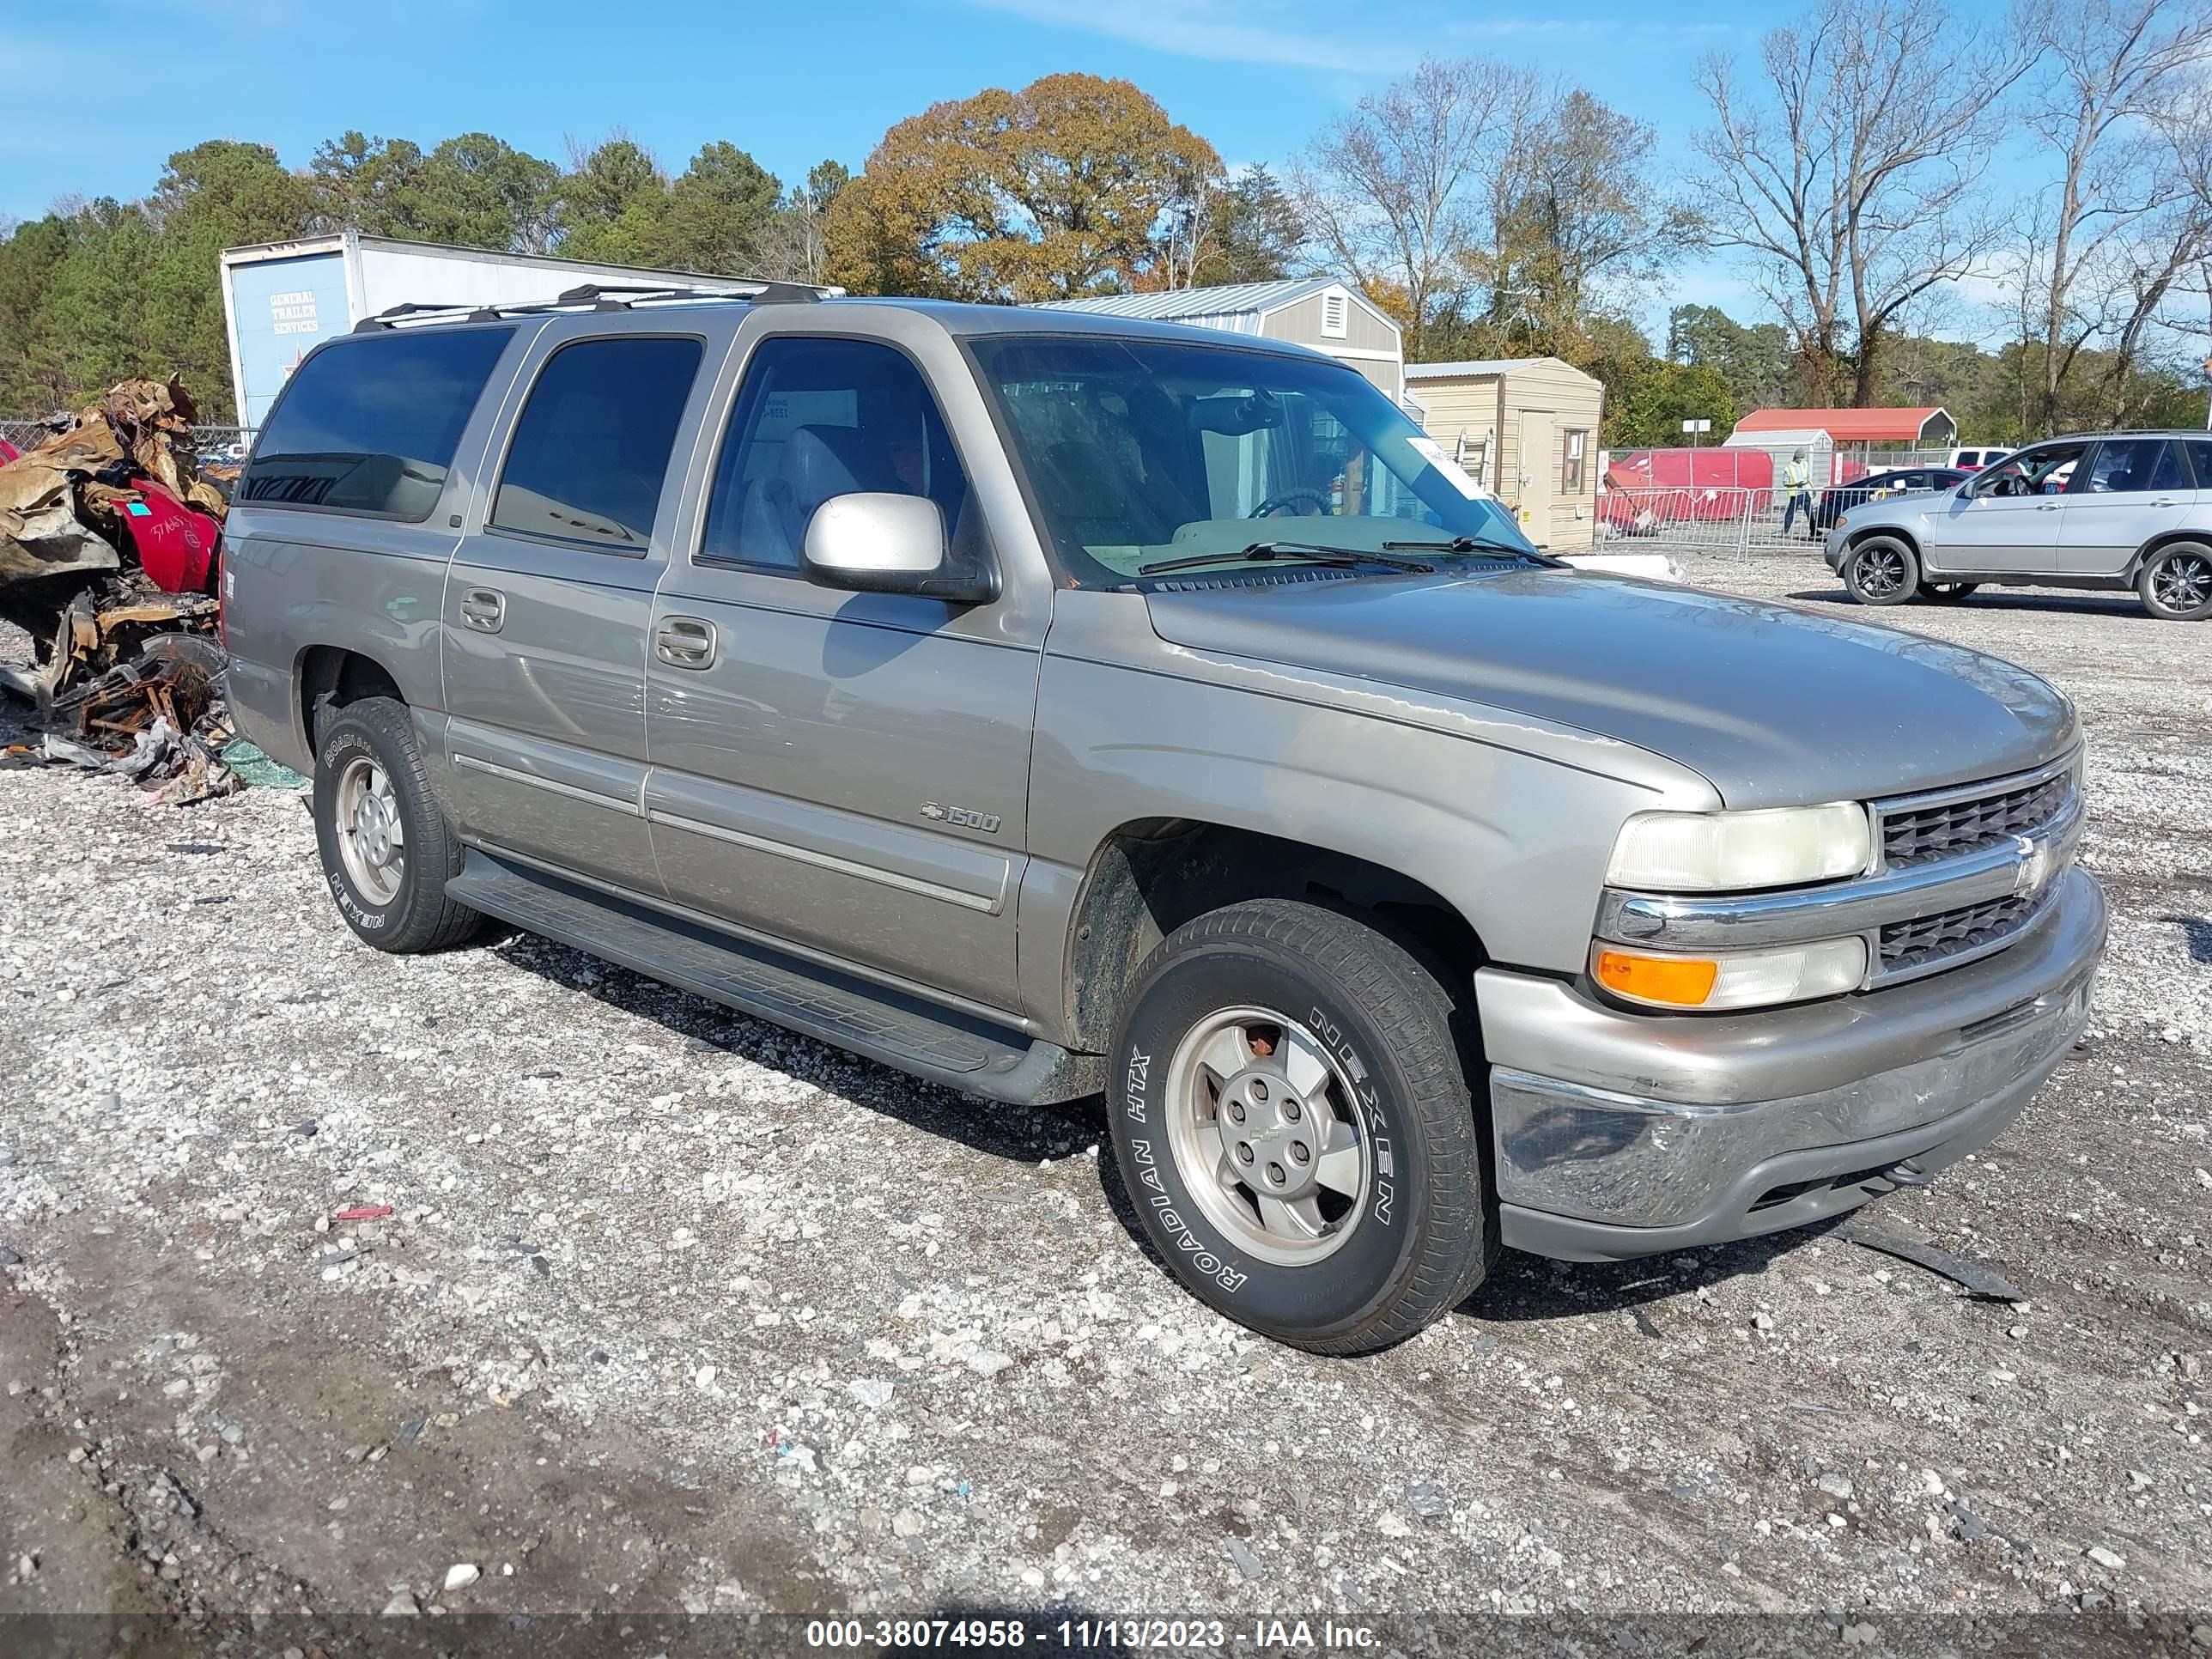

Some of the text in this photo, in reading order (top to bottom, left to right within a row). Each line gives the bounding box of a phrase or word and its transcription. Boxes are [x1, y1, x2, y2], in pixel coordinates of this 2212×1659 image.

[270, 291, 316, 306] GENERAL
[271, 305, 317, 320] TRAILER
[274, 320, 319, 335] SERVICES
[946, 805, 1001, 833] 1500
[331, 872, 385, 928] NEXEN
[1310, 1006, 1394, 1225] NEXEN
[1127, 1044, 1249, 1293] ROADIAN HTX
